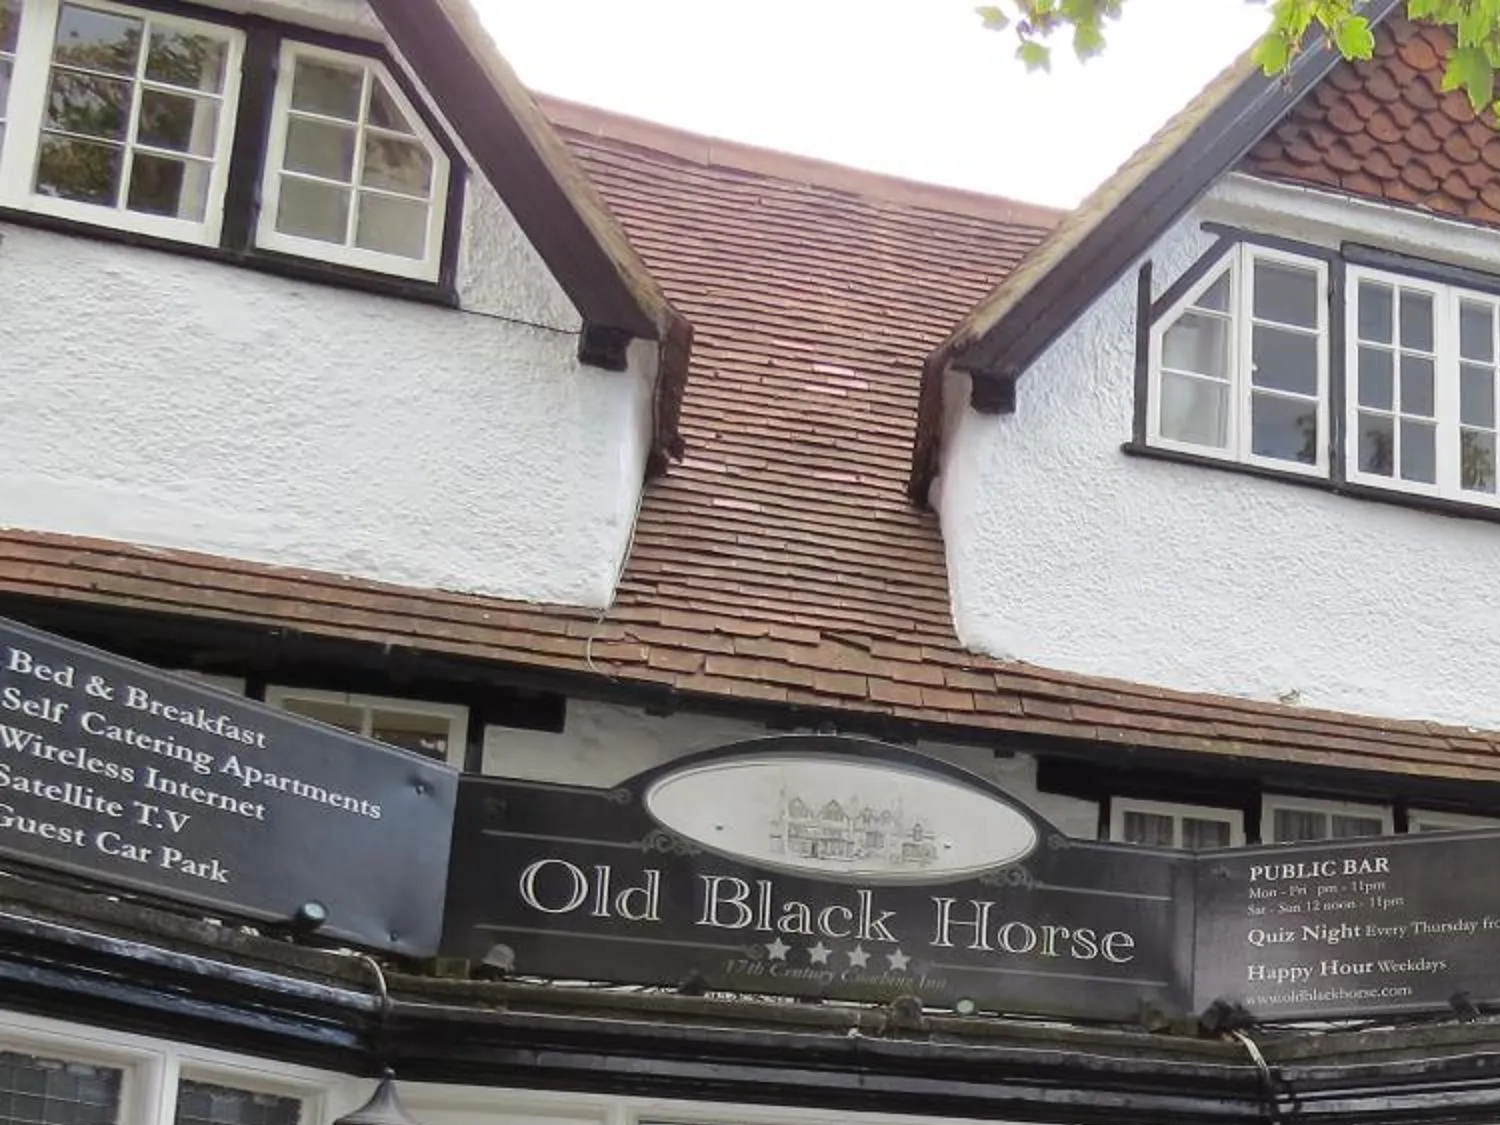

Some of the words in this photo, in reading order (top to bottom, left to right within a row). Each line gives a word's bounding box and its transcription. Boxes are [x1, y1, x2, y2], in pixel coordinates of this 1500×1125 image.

[7, 646, 75, 688] Bed
[85, 675, 115, 701] &
[125, 685, 267, 749] Breakfast
[0, 723, 135, 783] Wireless
[145, 766, 266, 822] Internet
[2, 687, 69, 725] Self
[81, 711, 214, 775] Catering
[220, 755, 382, 819] Apartments
[0, 763, 124, 817] Satellite
[133, 800, 191, 833] T.V
[96, 831, 152, 863] Car
[160, 845, 229, 883] Park
[1250, 861, 1337, 881] PUBLIC
[1343, 857, 1390, 874] BAR
[519, 858, 660, 921] Old
[697, 873, 900, 943] Black
[929, 896, 1135, 963] Horse
[1250, 887, 1277, 898] Mon
[1247, 928, 1296, 946] Quiz
[1301, 924, 1361, 944] Night
[1366, 925, 1407, 939] Every
[1411, 920, 1478, 935] Thursday
[1248, 964, 1313, 983] Happy
[1319, 960, 1375, 976] Hour
[1377, 958, 1447, 973] Weekdays
